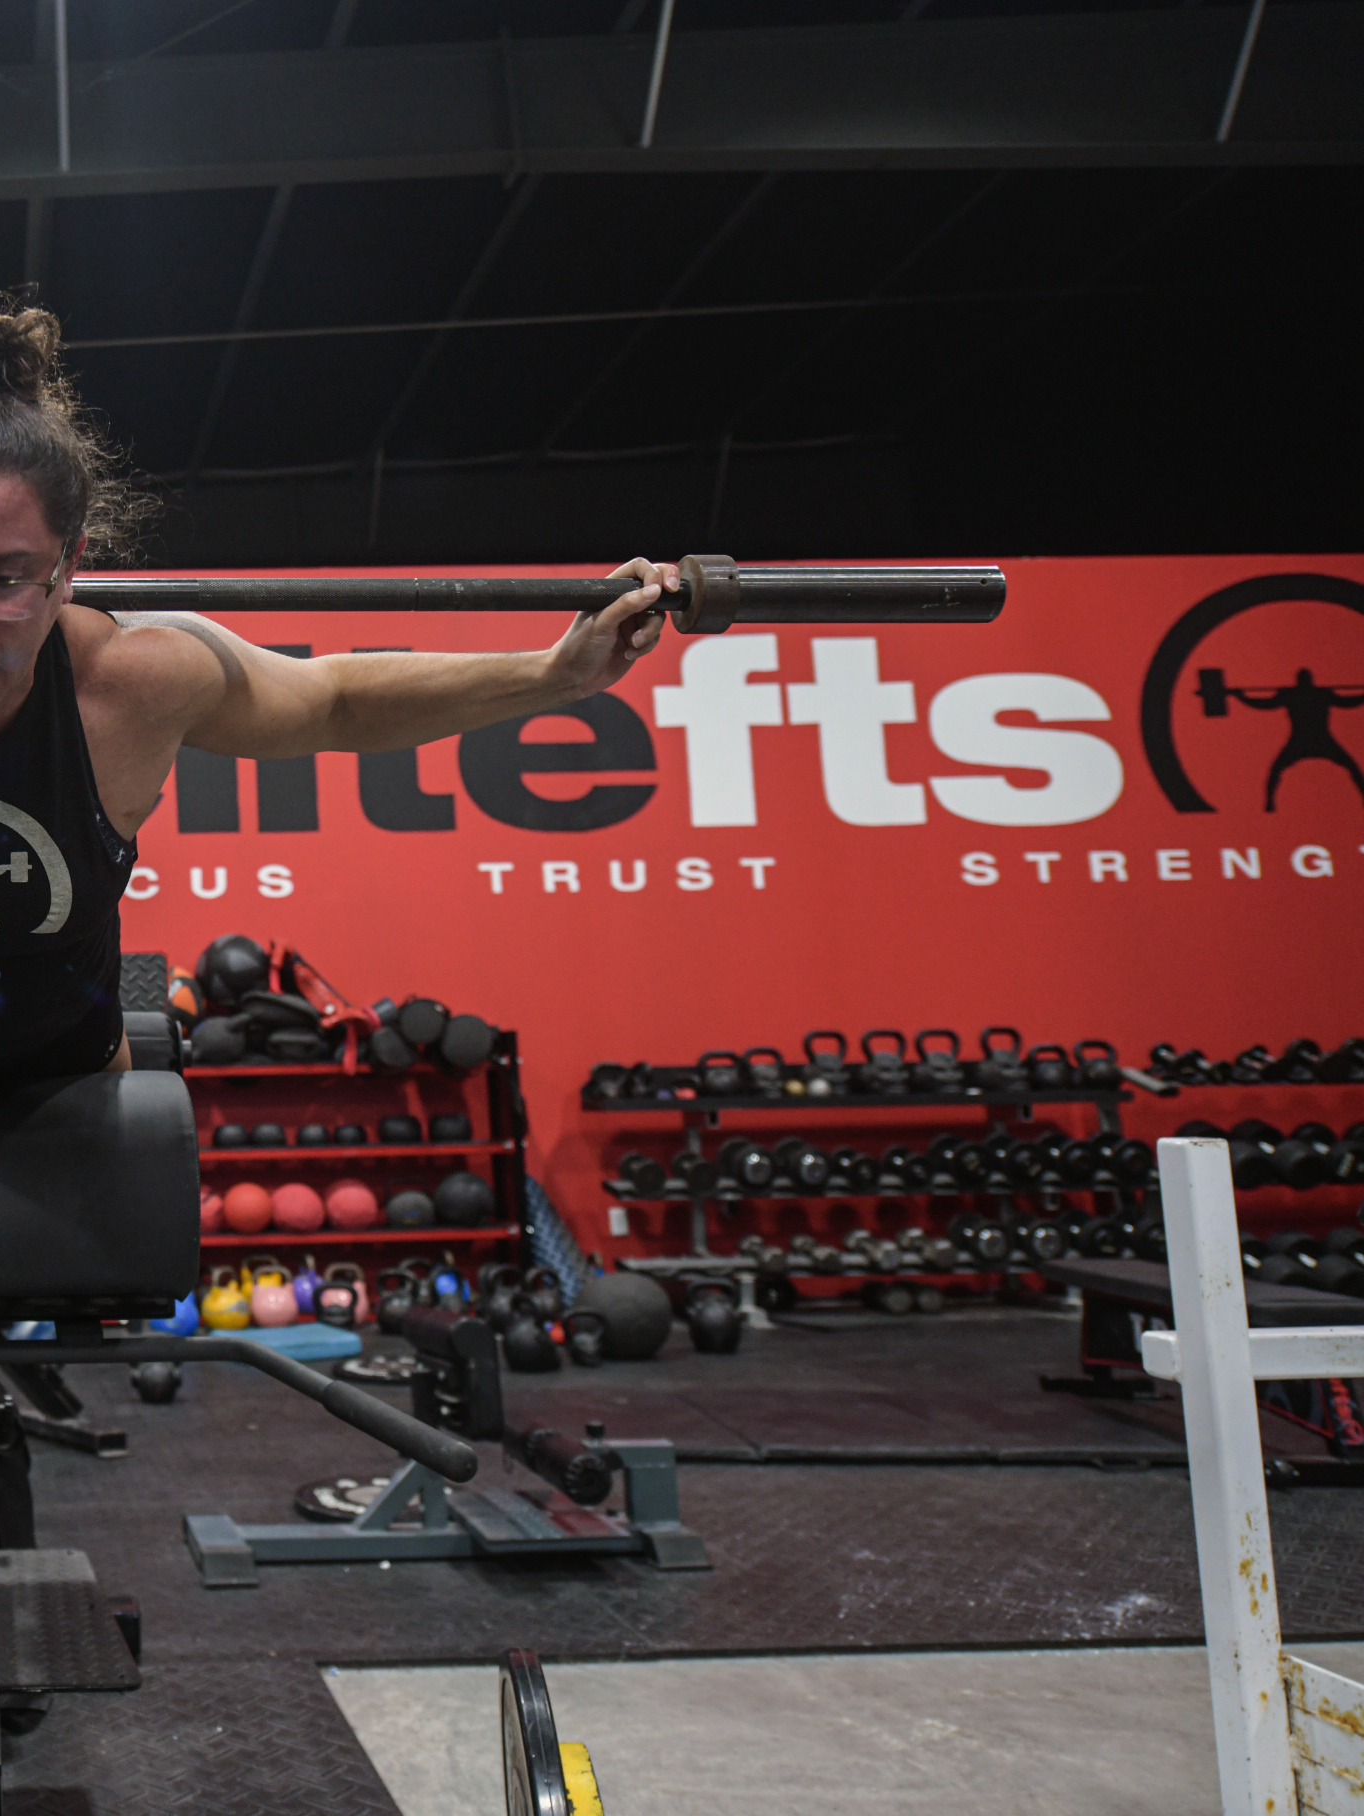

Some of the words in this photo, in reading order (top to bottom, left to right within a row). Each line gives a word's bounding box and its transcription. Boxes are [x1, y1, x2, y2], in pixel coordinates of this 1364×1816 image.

[123, 864, 294, 900] CUS
[477, 857, 776, 894] TRUST
[961, 845, 1364, 886] STRENG
